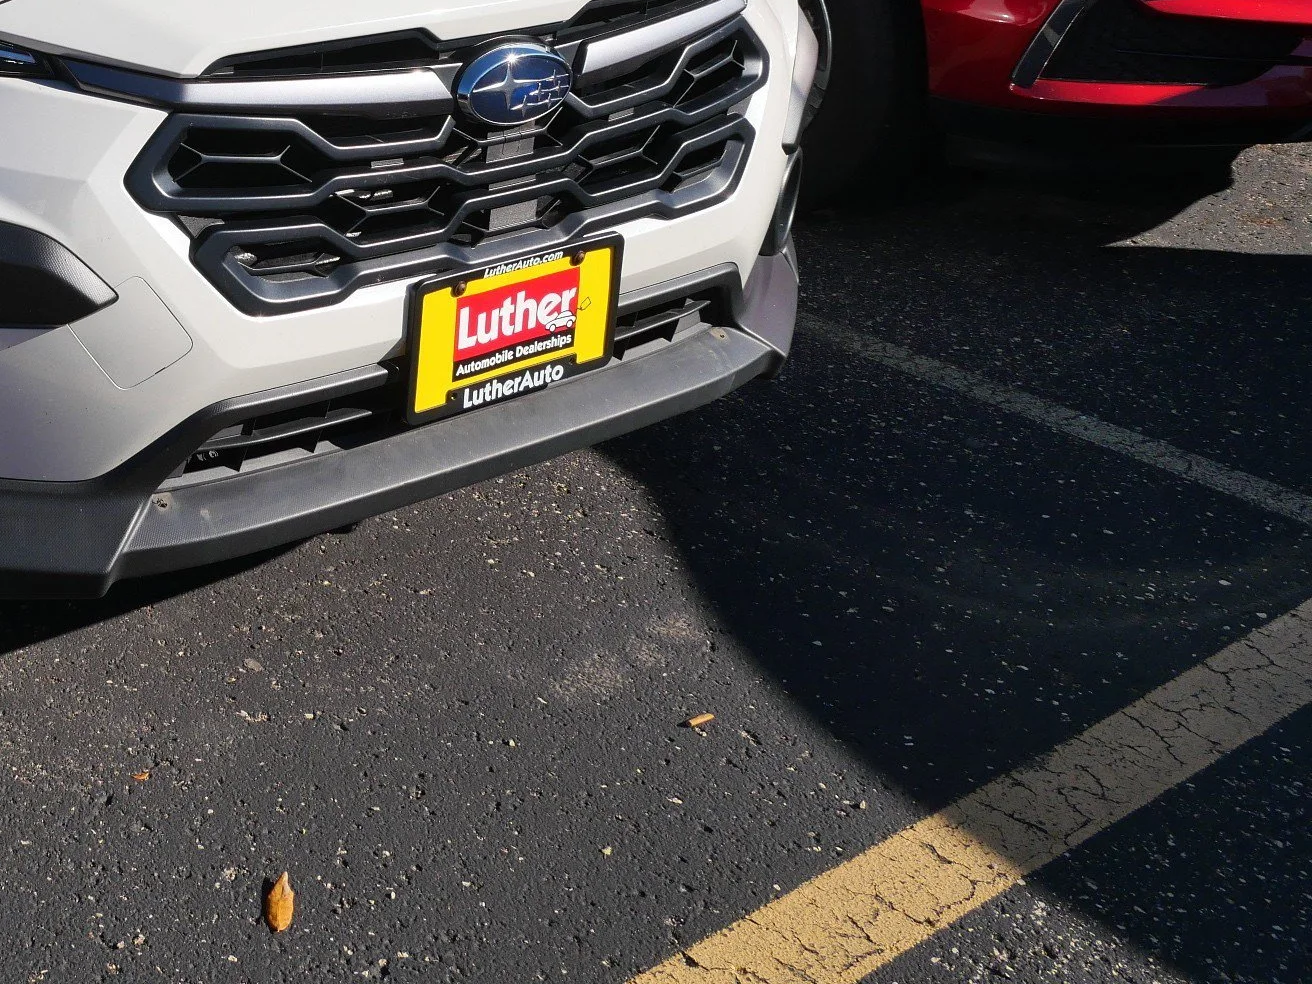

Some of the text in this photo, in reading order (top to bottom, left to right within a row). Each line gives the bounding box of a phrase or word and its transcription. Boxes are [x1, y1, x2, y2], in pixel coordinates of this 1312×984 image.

[483, 250, 564, 279] LutherAuto.com
[457, 286, 578, 351] Luther
[455, 333, 572, 377] Automobile Dealerships
[462, 364, 564, 409] LutherAuto
